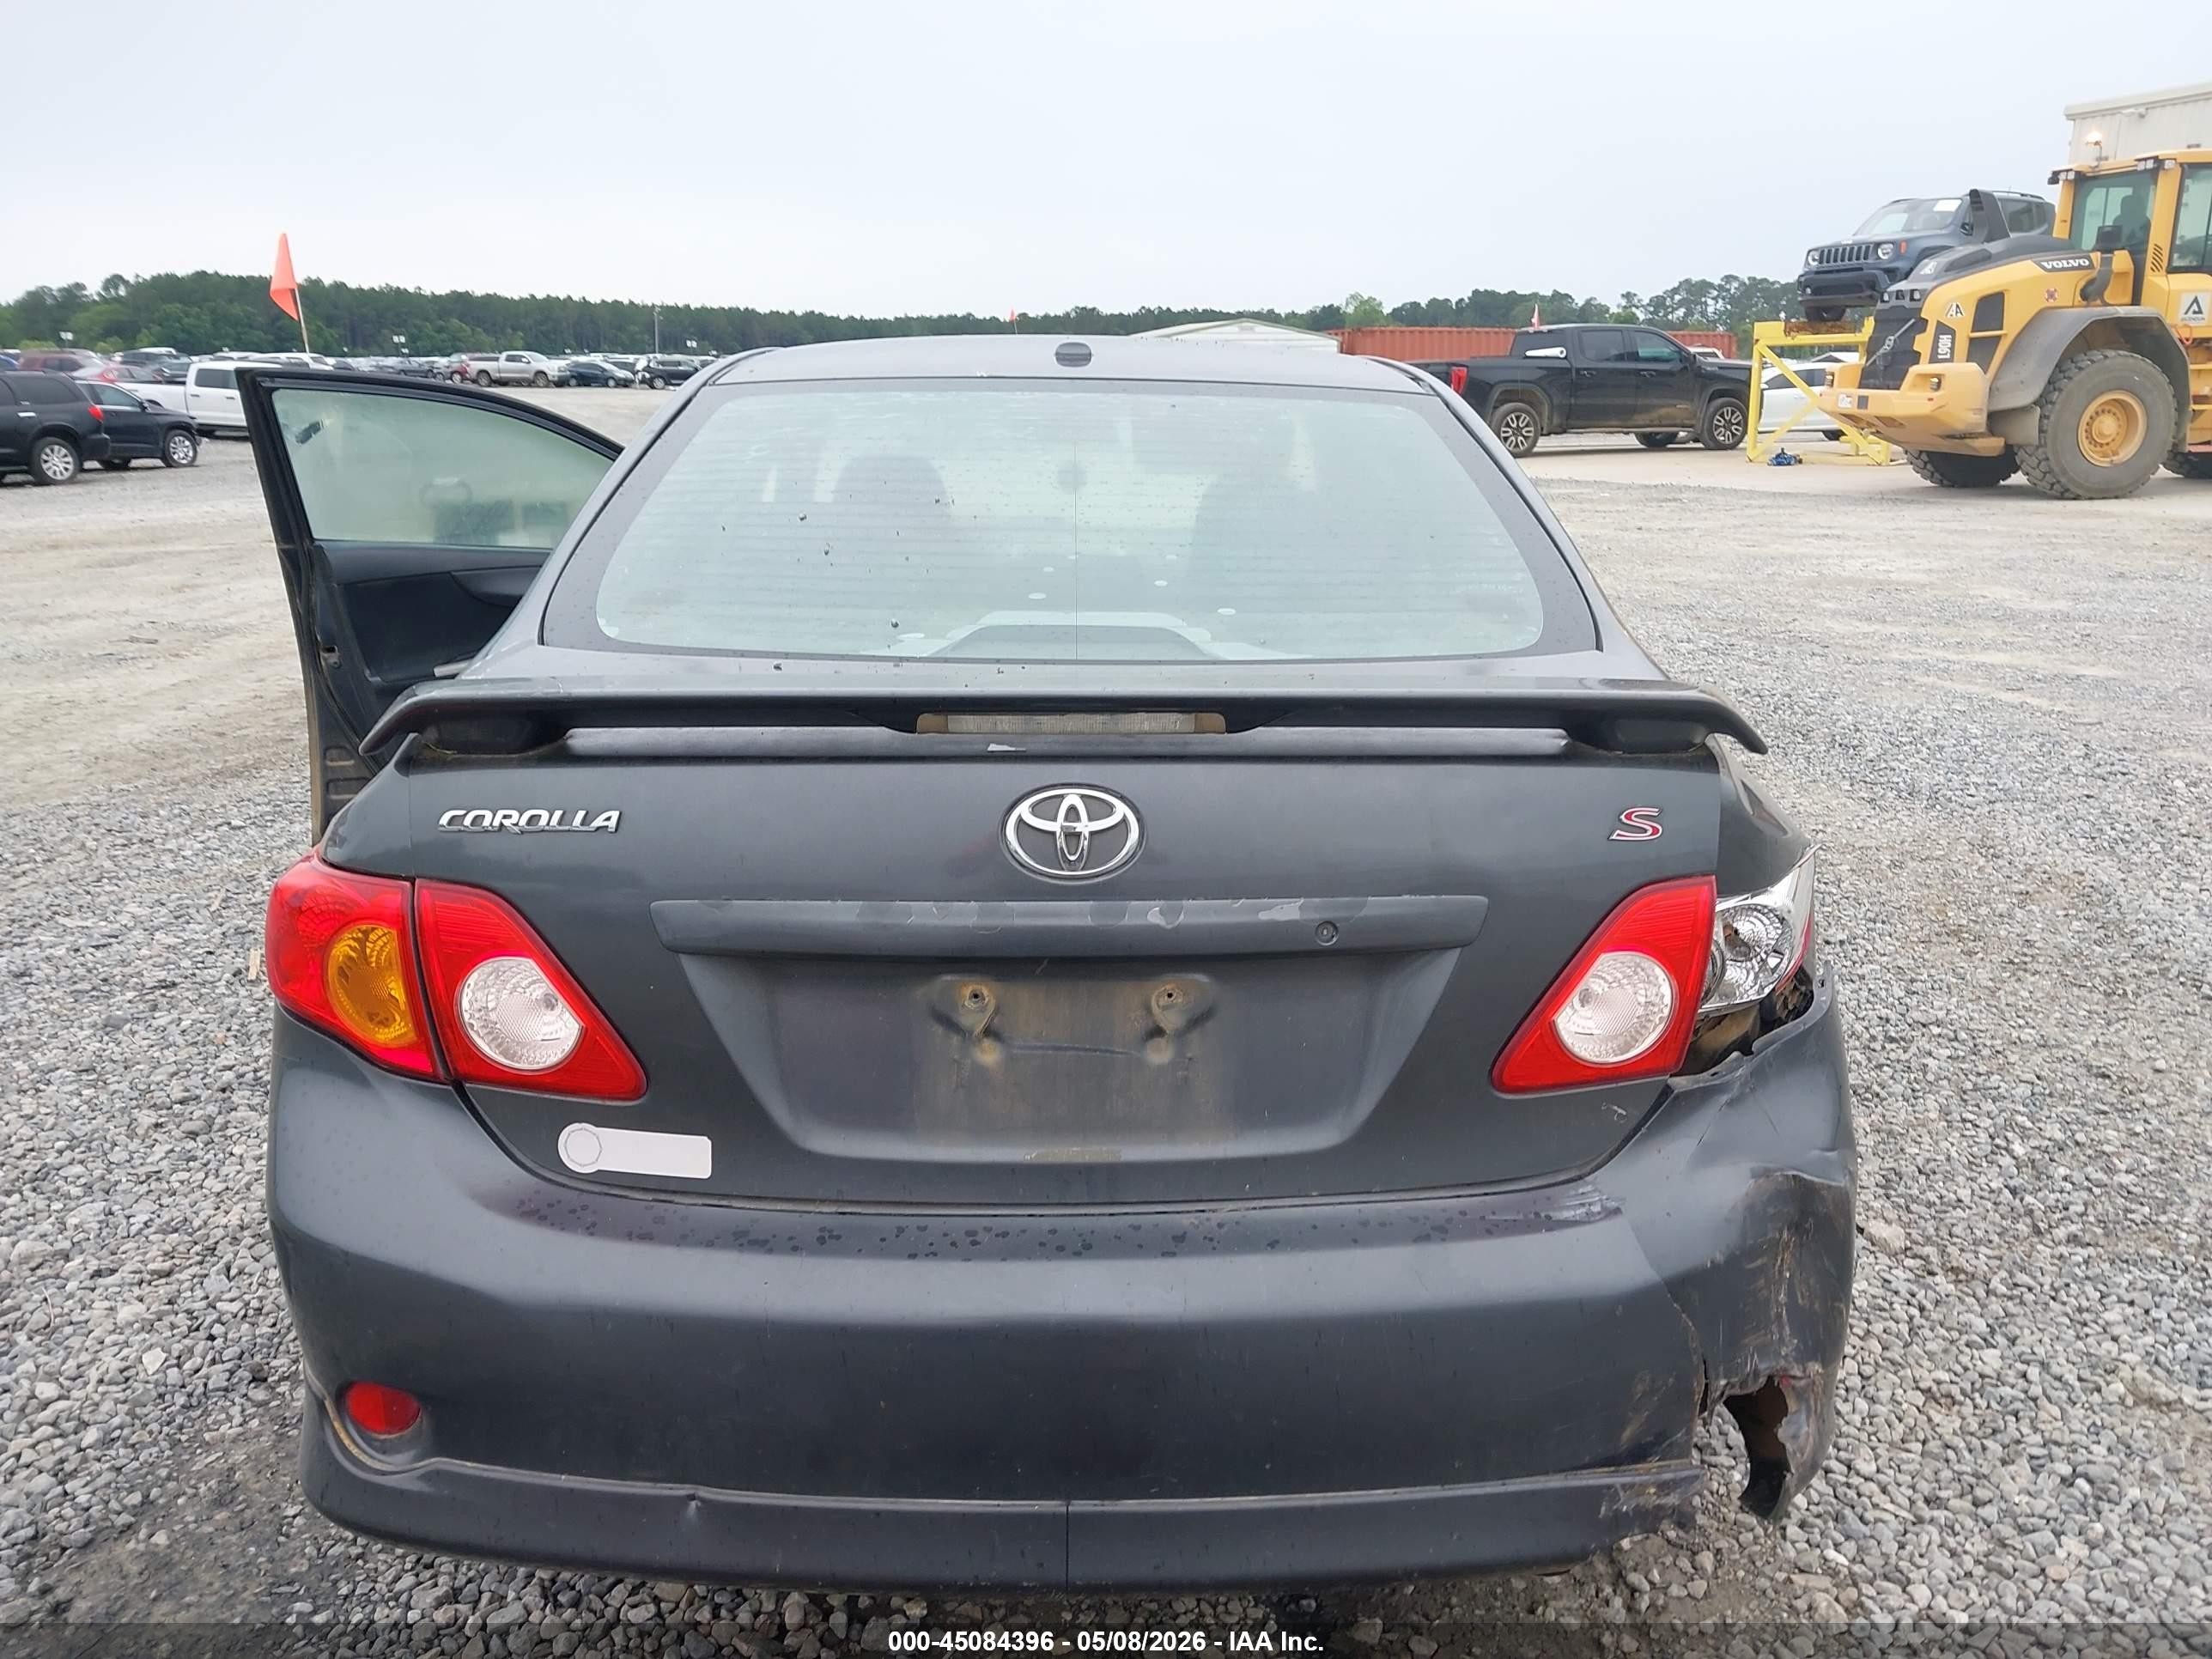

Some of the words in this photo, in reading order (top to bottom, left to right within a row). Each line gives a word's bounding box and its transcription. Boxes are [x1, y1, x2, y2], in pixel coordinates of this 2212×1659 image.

[2040, 258, 2089, 269] VOLVO
[1937, 335, 1952, 359] L90H
[439, 809, 620, 834] COROLLA
[1608, 807, 1662, 841] S
